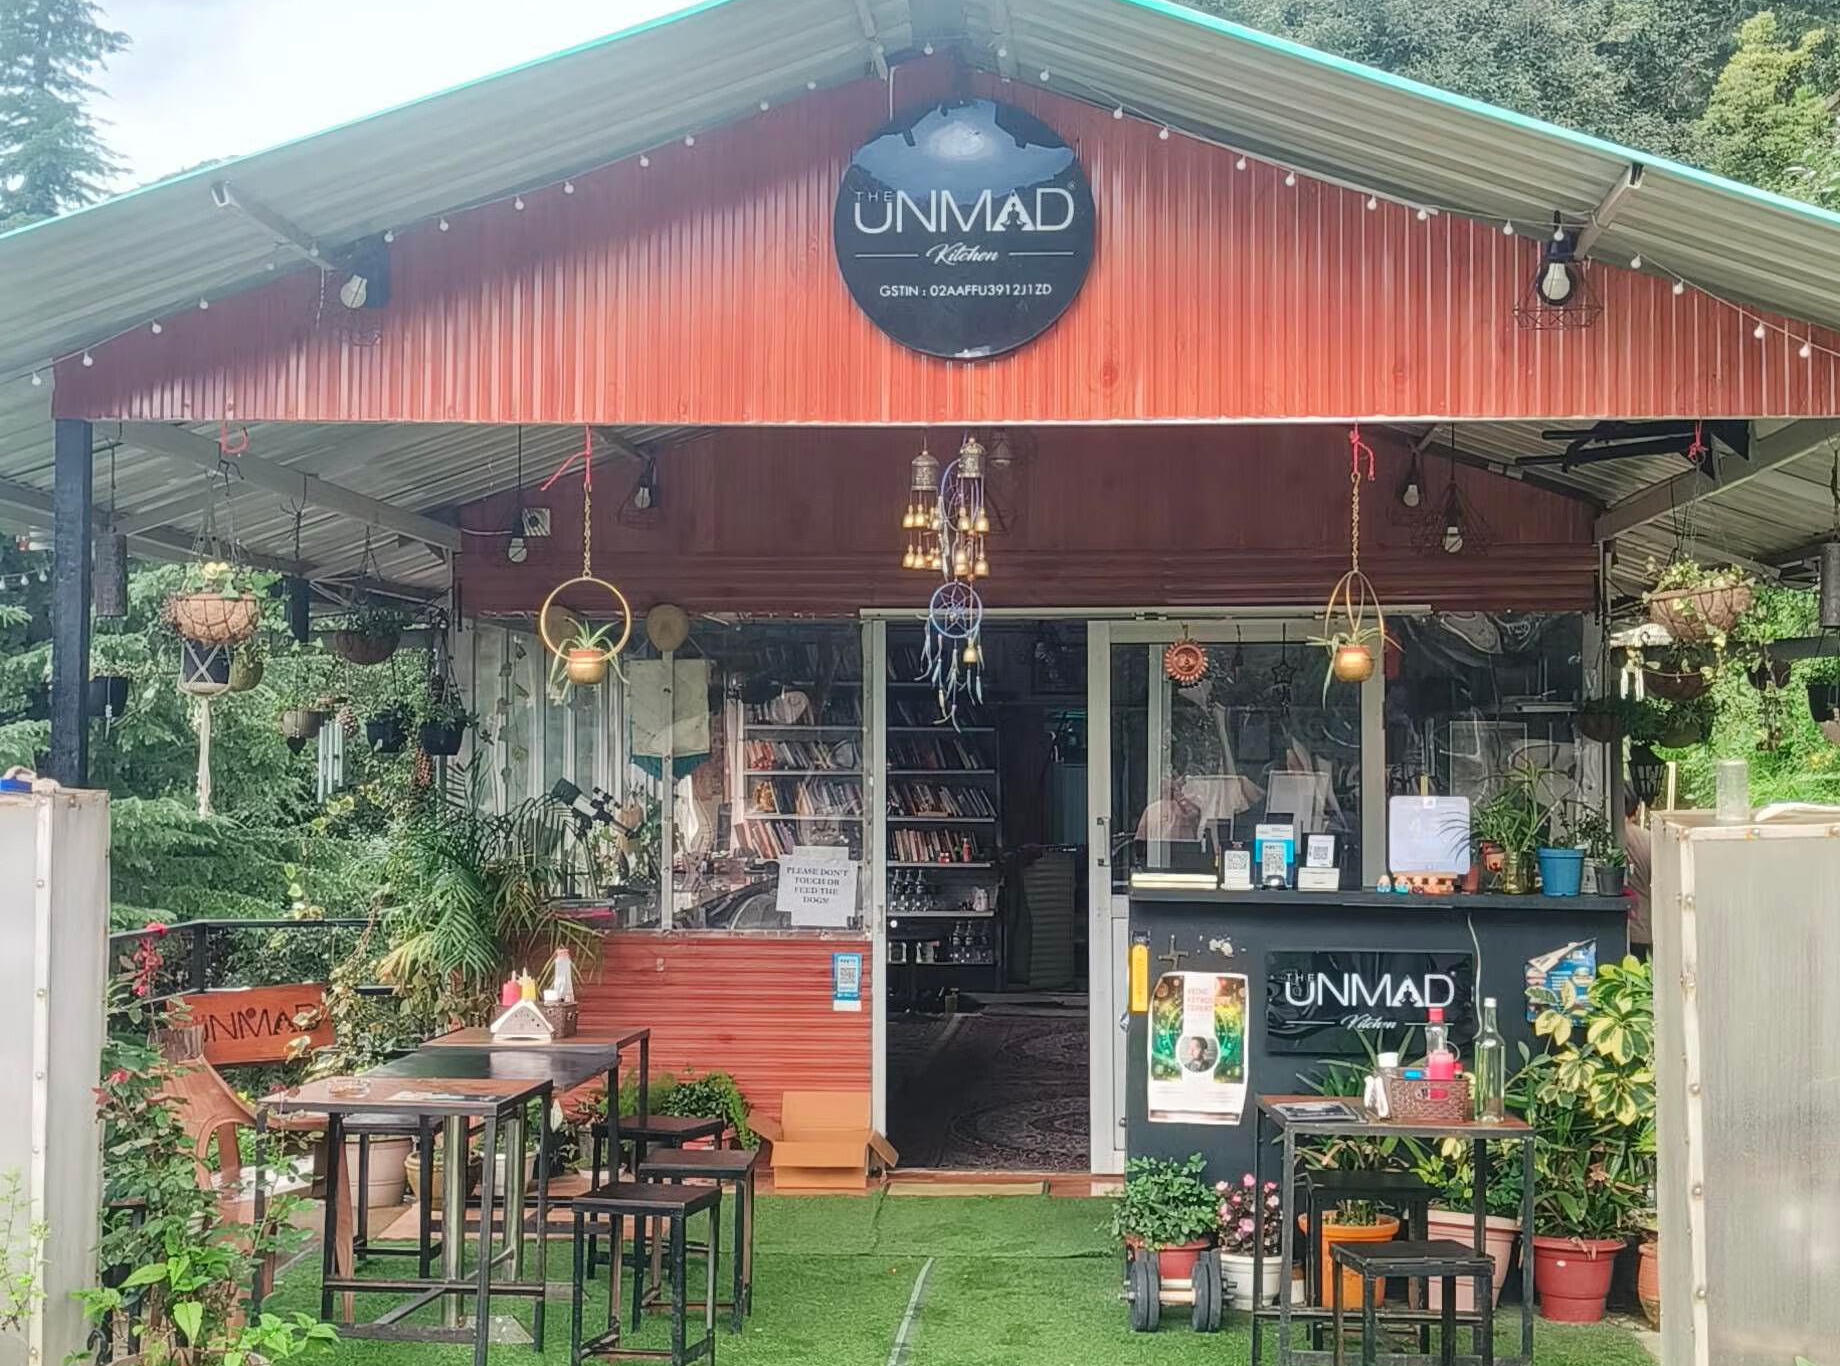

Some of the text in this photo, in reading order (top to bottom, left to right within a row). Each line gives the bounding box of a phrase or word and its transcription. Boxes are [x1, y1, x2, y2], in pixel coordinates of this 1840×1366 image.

[854, 190, 893, 203] THE
[854, 187, 1075, 234] UNMAD
[925, 242, 999, 267] Kitchen
[879, 285, 919, 298] GSTIN
[929, 283, 1052, 297] 02AAFFU3912J1ZD
[786, 866, 848, 877] PLEASE DON'T
[795, 876, 840, 886] TOUCH OR
[794, 886, 839, 896] FEED THE
[1286, 973, 1315, 982] THE
[1285, 972, 1455, 1008] UNMAD
[1340, 1013, 1398, 1031] Kitchen
